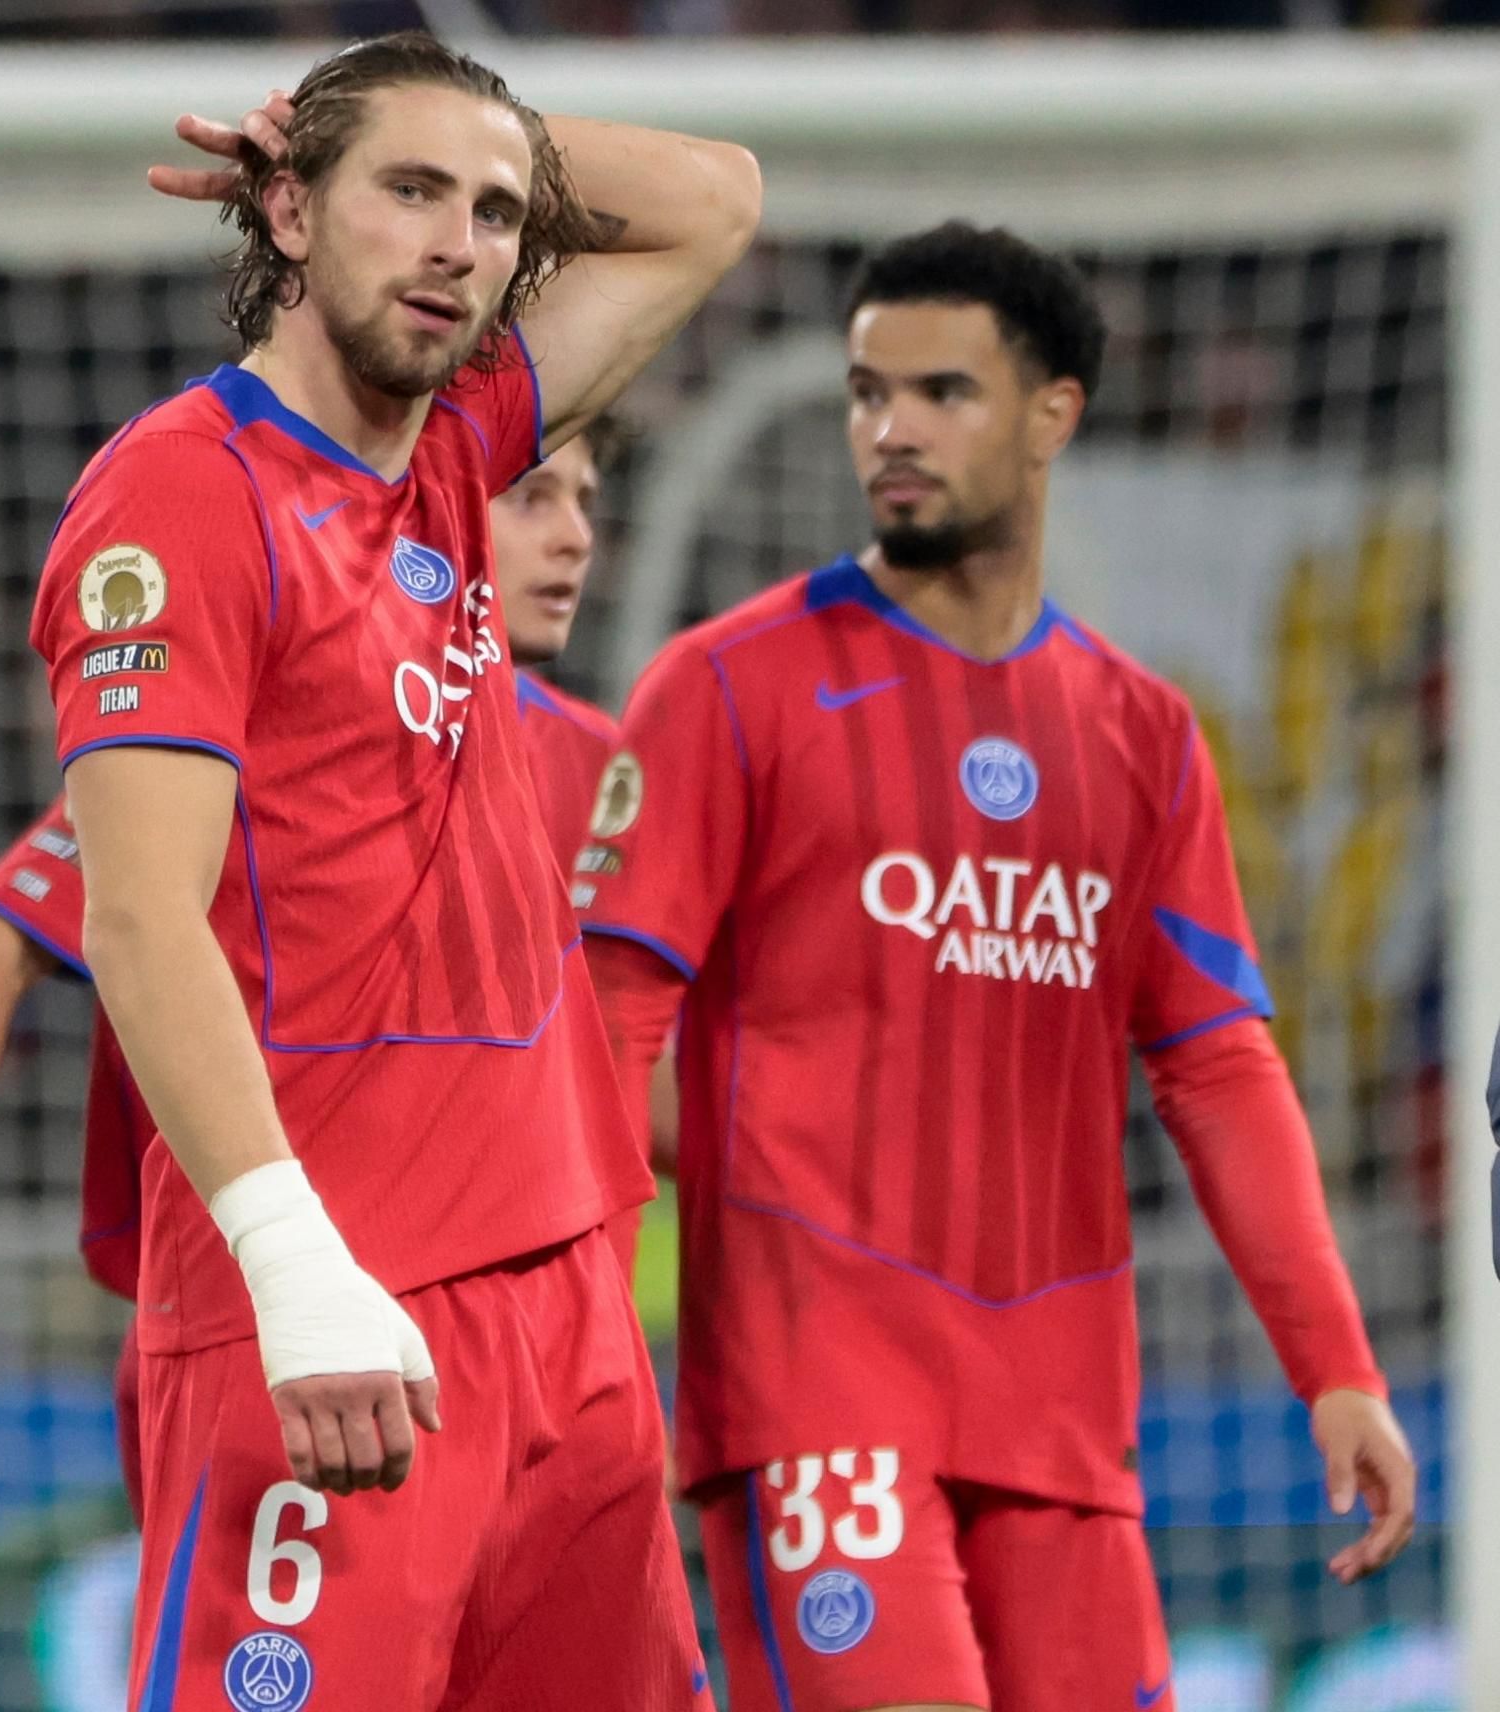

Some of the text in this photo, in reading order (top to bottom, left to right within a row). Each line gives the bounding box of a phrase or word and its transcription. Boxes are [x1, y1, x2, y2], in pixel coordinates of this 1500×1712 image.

[82, 649, 120, 679] LIGUE
[766, 1450, 904, 1572] 33
[247, 1480, 328, 1626] 6
[244, 1637, 300, 1663] PARIS
